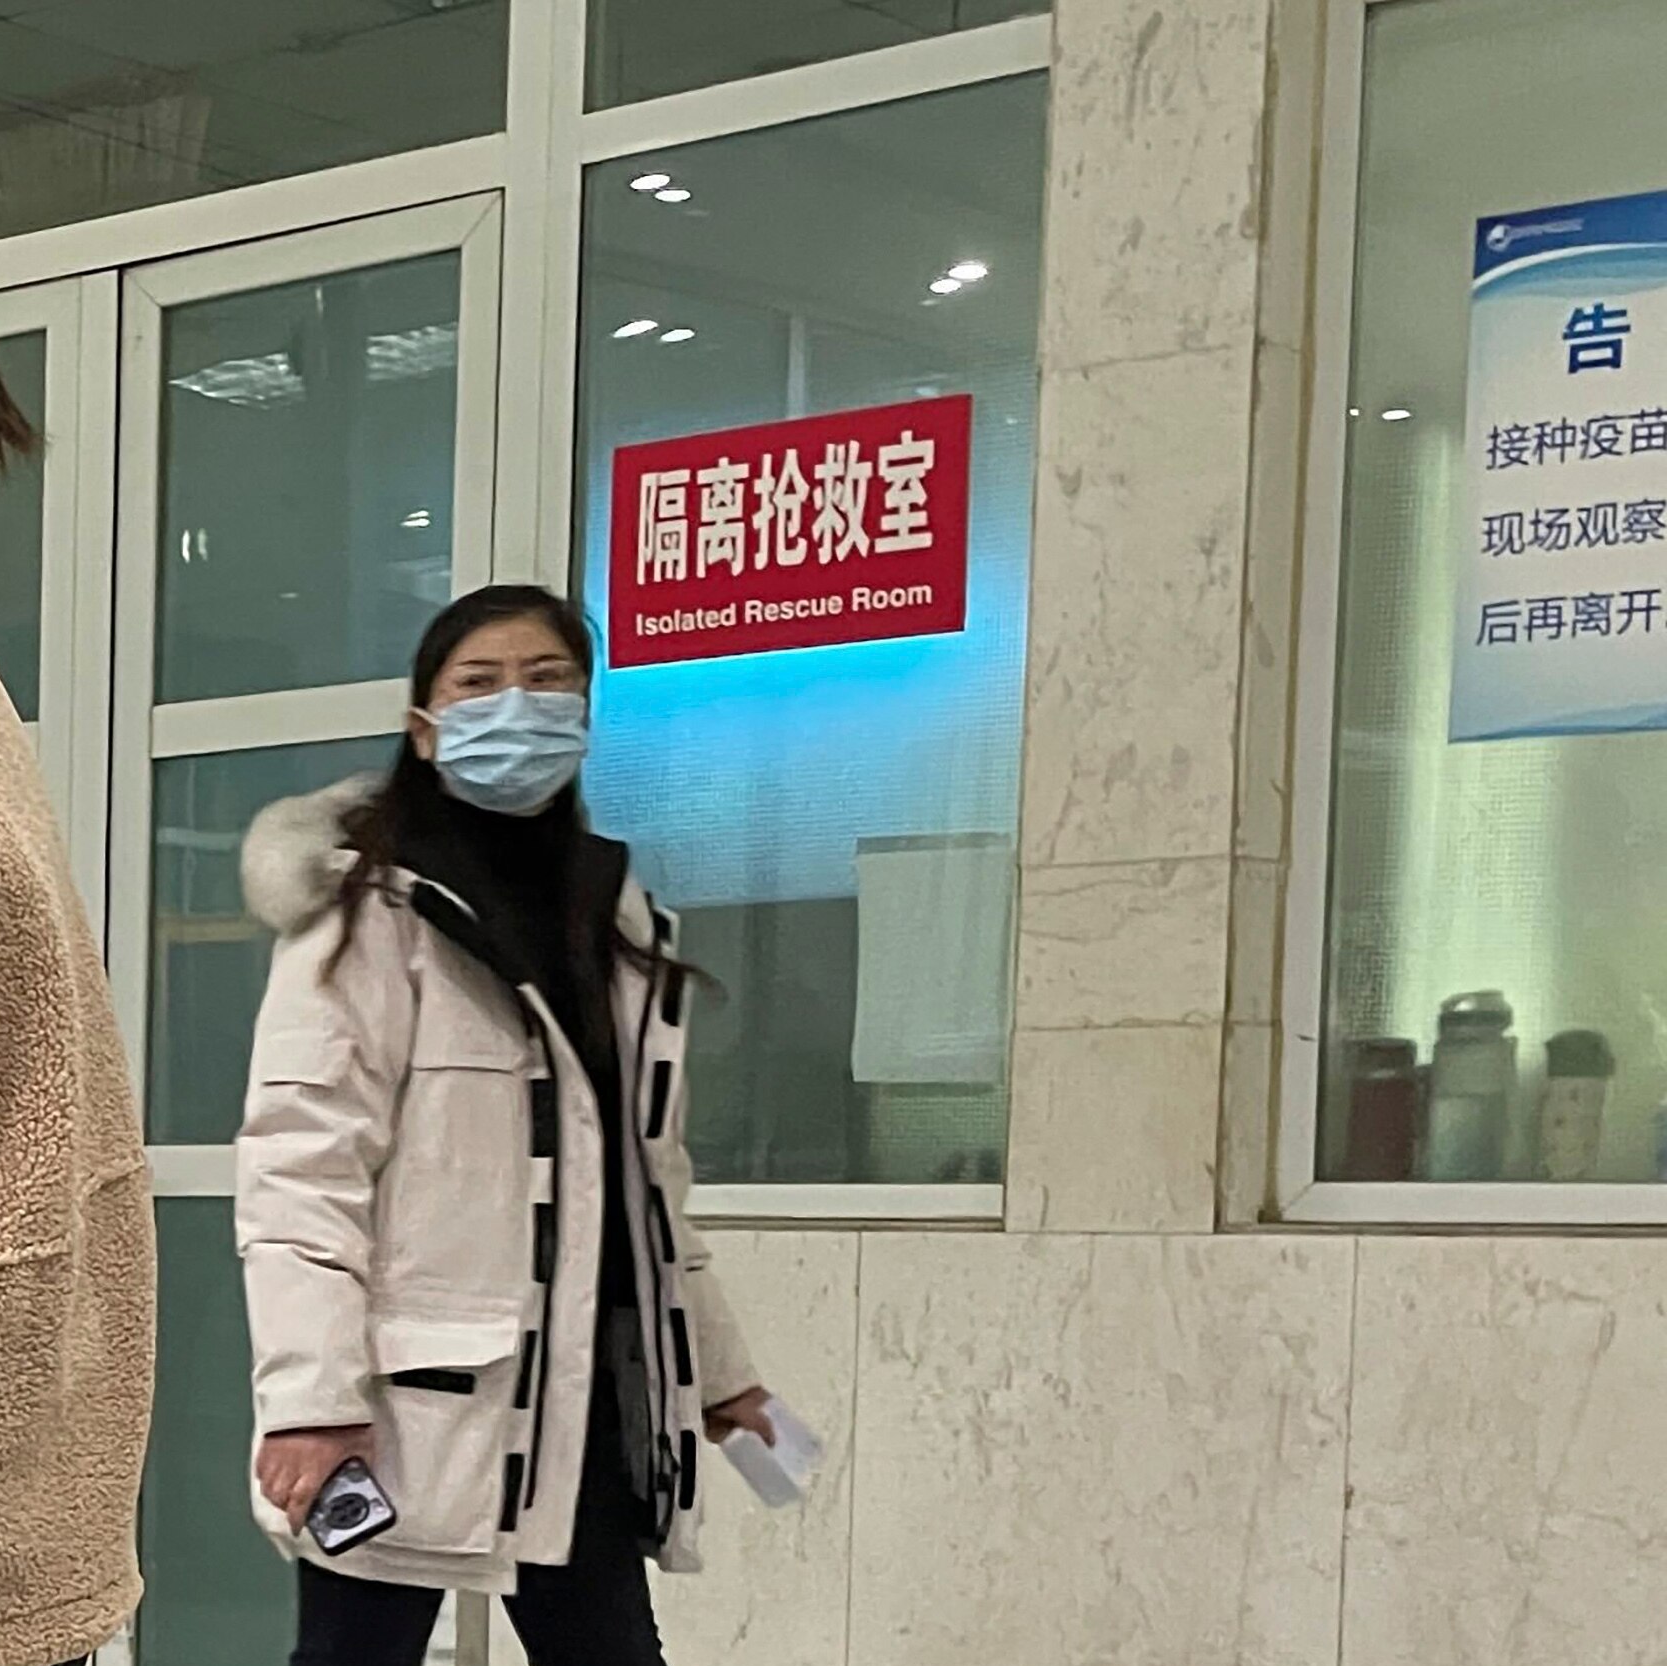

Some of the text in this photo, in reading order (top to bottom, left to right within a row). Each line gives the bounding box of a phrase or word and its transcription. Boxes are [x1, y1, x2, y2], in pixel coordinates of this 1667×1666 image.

[1562, 302, 1632, 375] 告
[1485, 406, 1667, 471] 接种疫苗
[636, 429, 936, 586] 隔离抢救室
[1480, 498, 1667, 558] 现场观察
[636, 583, 933, 637] Isolated Rescue Room
